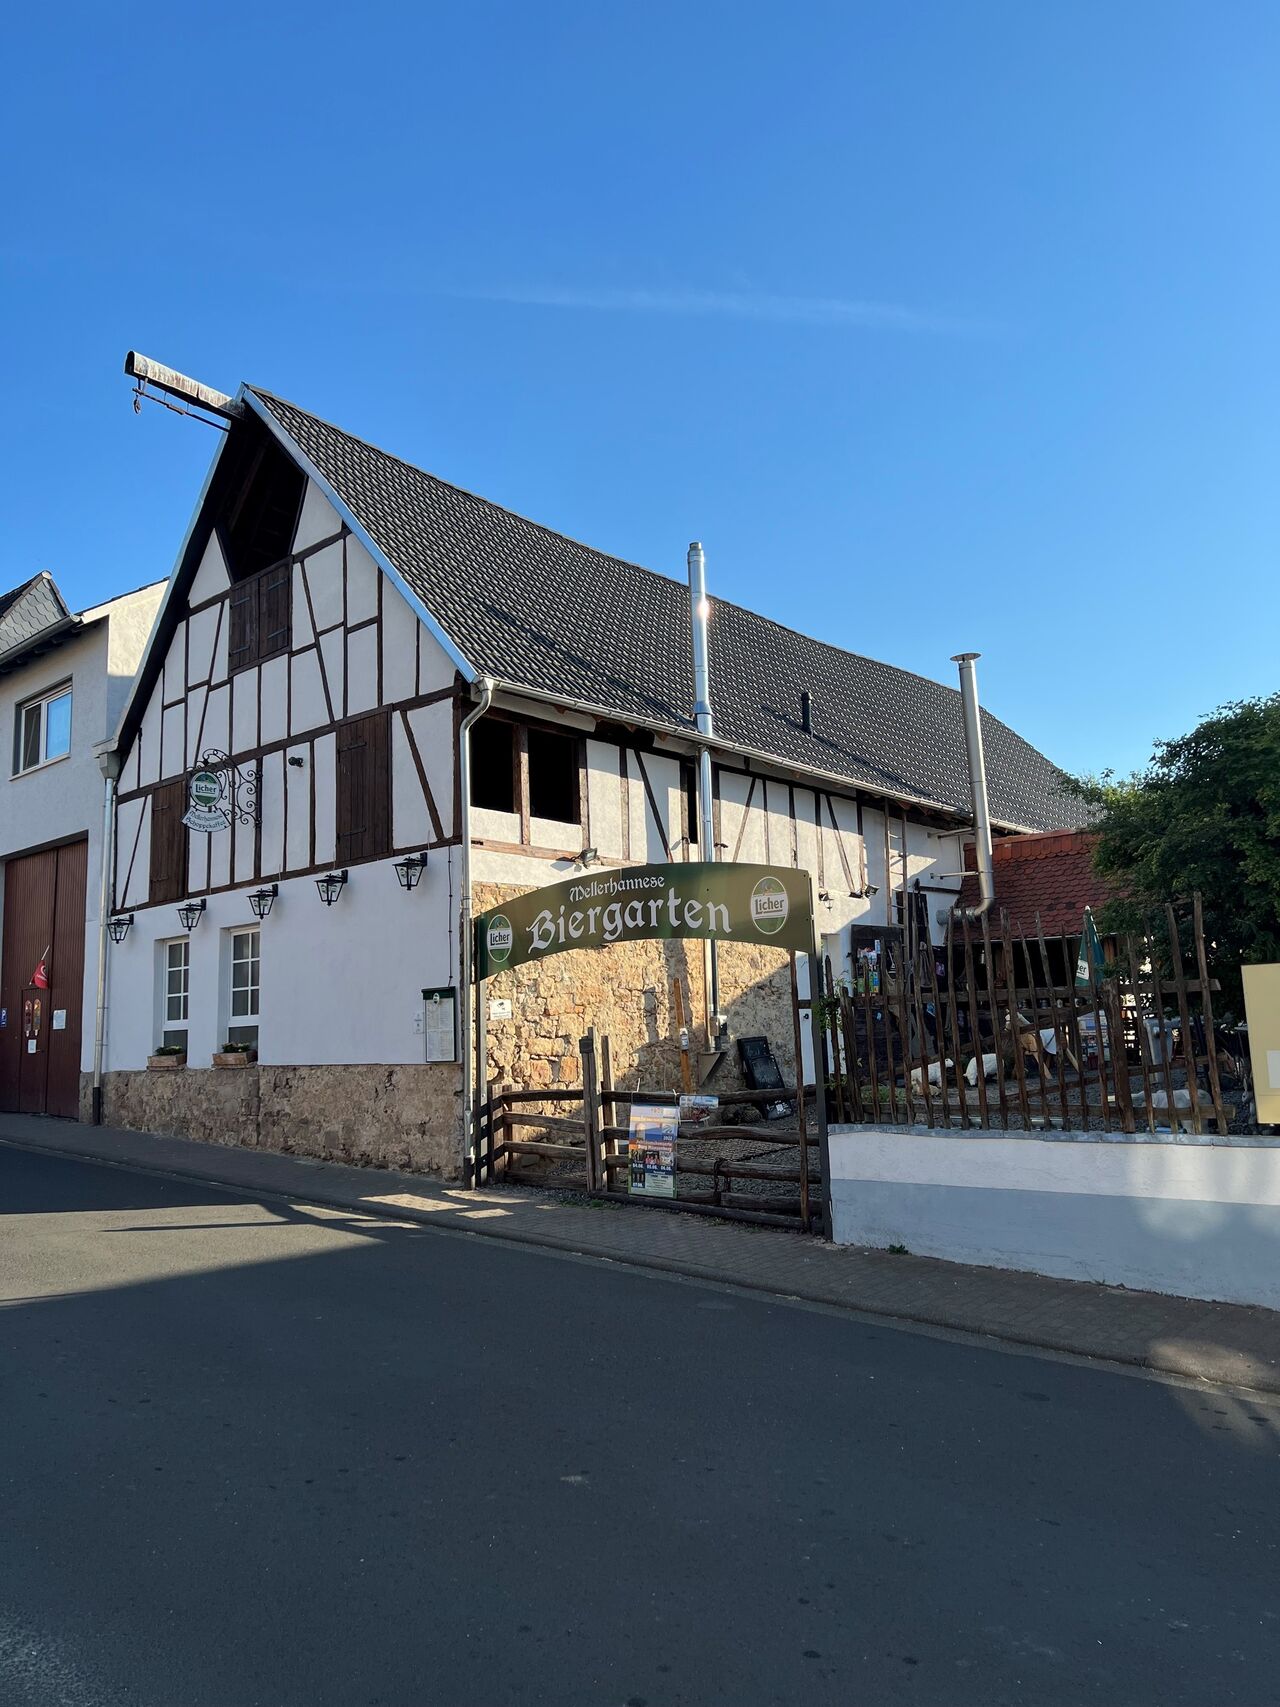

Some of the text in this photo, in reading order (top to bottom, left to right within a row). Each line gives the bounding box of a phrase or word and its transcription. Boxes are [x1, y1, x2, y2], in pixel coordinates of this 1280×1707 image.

[195, 783, 217, 794] Licher
[569, 875, 665, 902] Mellerhannese
[755, 897, 785, 915] Licher
[526, 887, 732, 954] Biergarten
[490, 932, 510, 946] Licher
